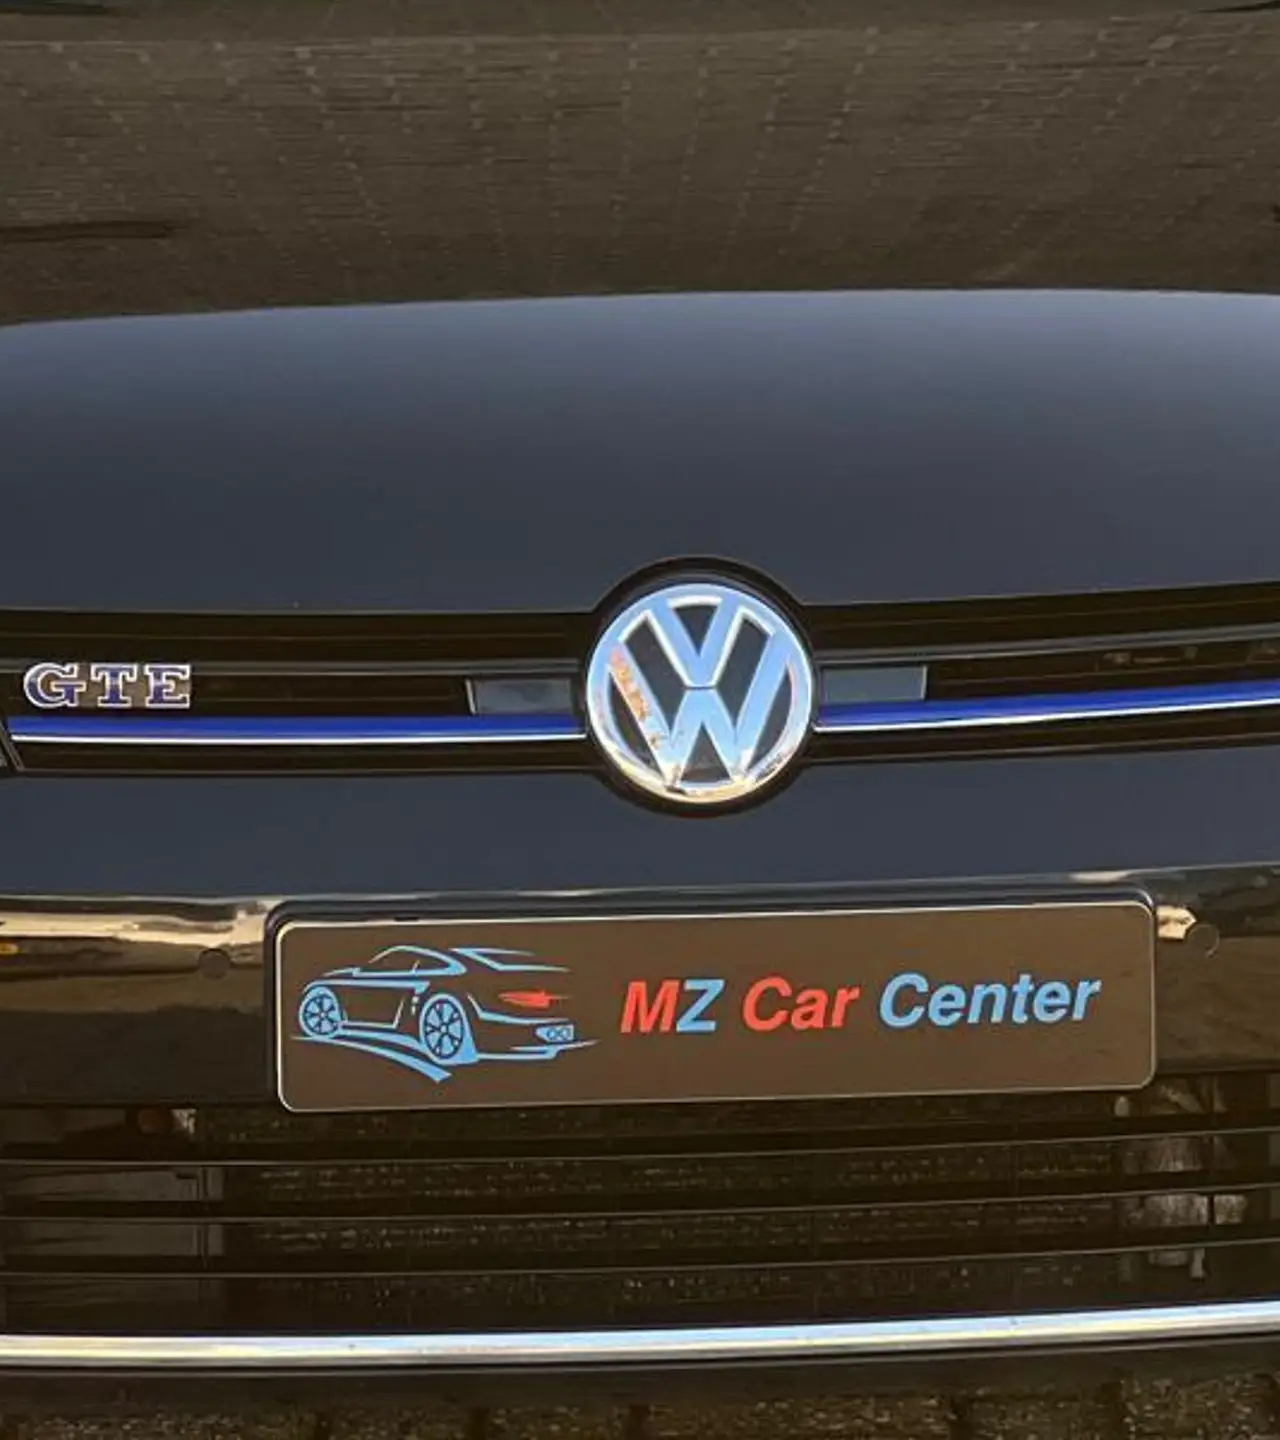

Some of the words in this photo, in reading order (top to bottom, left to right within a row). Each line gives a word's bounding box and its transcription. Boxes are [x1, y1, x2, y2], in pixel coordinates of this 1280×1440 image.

[23, 662, 191, 708] GTE
[620, 978, 724, 1034] MZ
[742, 976, 860, 1031] Car
[879, 971, 1101, 1028] Center
